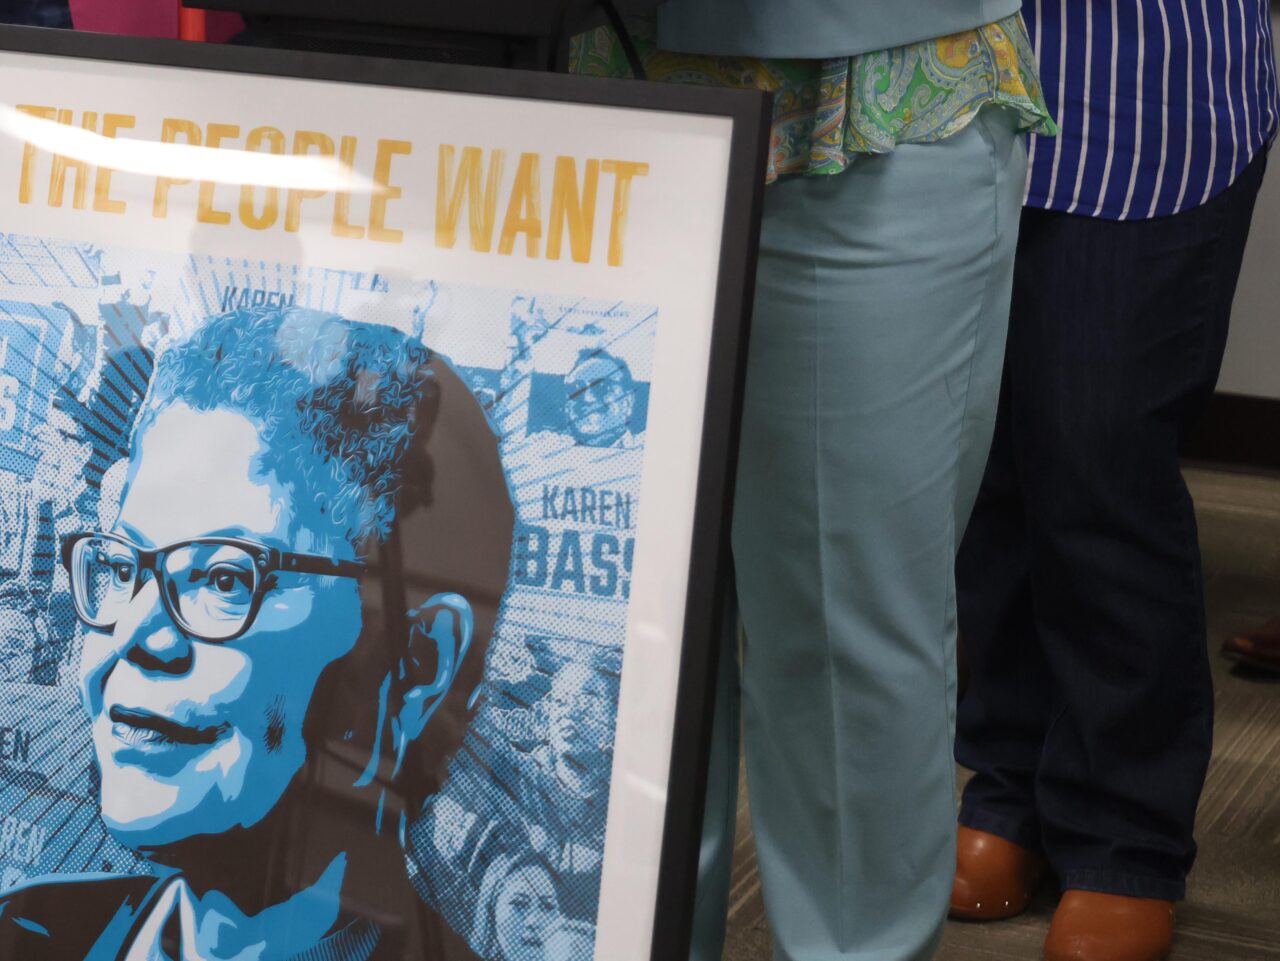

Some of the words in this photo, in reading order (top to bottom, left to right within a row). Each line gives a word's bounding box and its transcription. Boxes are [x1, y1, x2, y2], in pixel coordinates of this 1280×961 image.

[15, 103, 136, 215] THE
[151, 117, 413, 243] PEOPLE
[434, 143, 650, 267] WANT
[542, 483, 633, 529] KAREN
